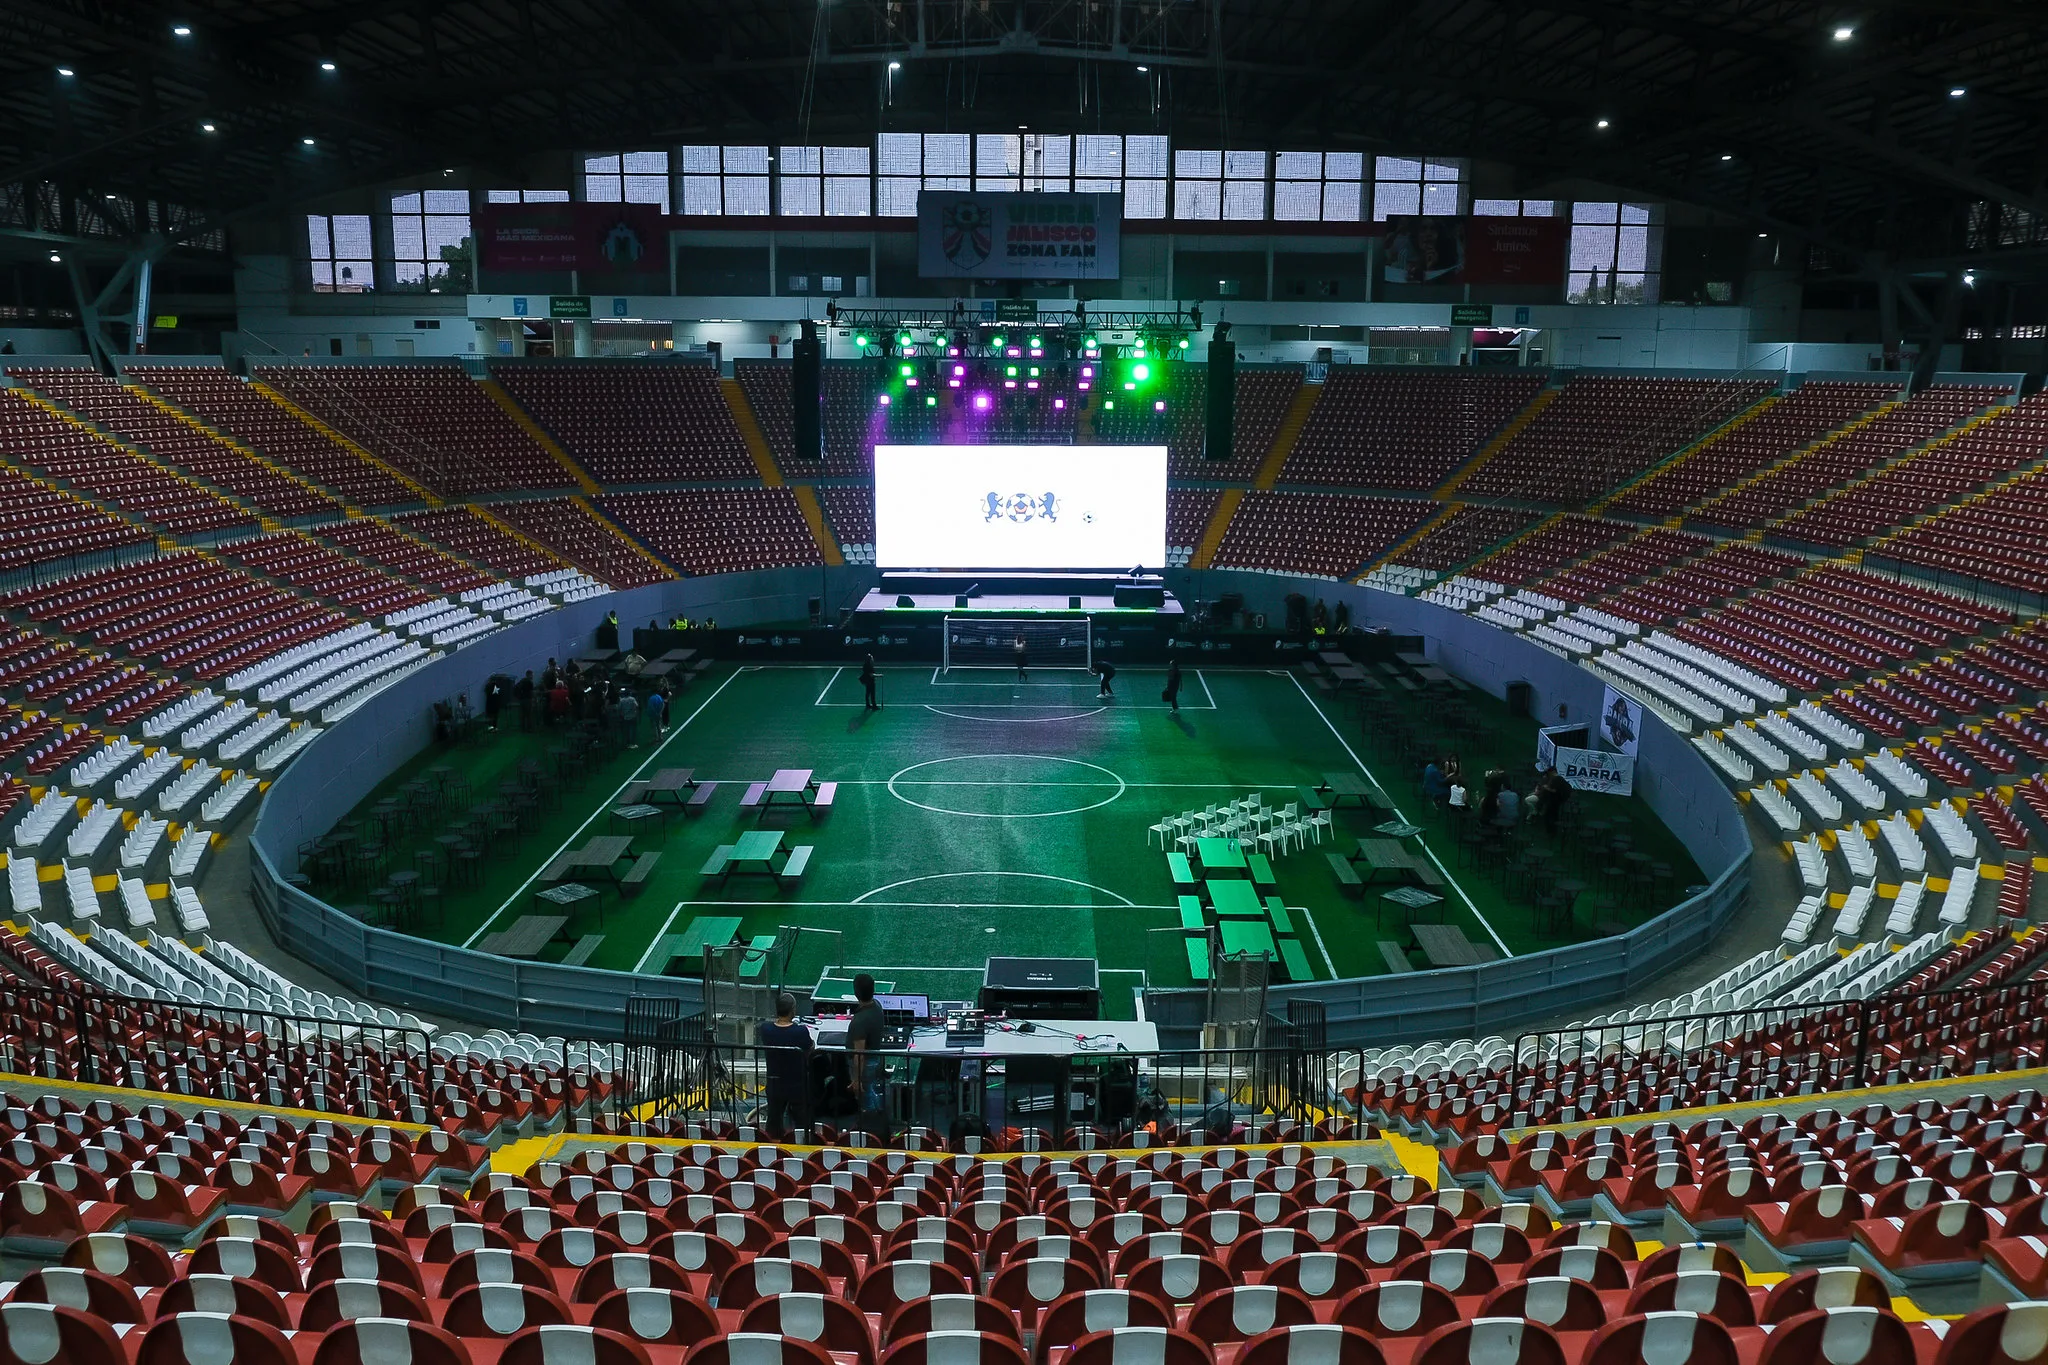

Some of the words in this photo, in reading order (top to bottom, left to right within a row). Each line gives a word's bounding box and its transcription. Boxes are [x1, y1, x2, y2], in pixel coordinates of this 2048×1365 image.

[1006, 225, 1097, 241] JALISCO
[1006, 243, 1058, 257] ZONA
[1060, 243, 1096, 257] FAN
[517, 303, 524, 313] 7
[616, 305, 624, 313] 8
[1566, 765, 1622, 783] BARRA
